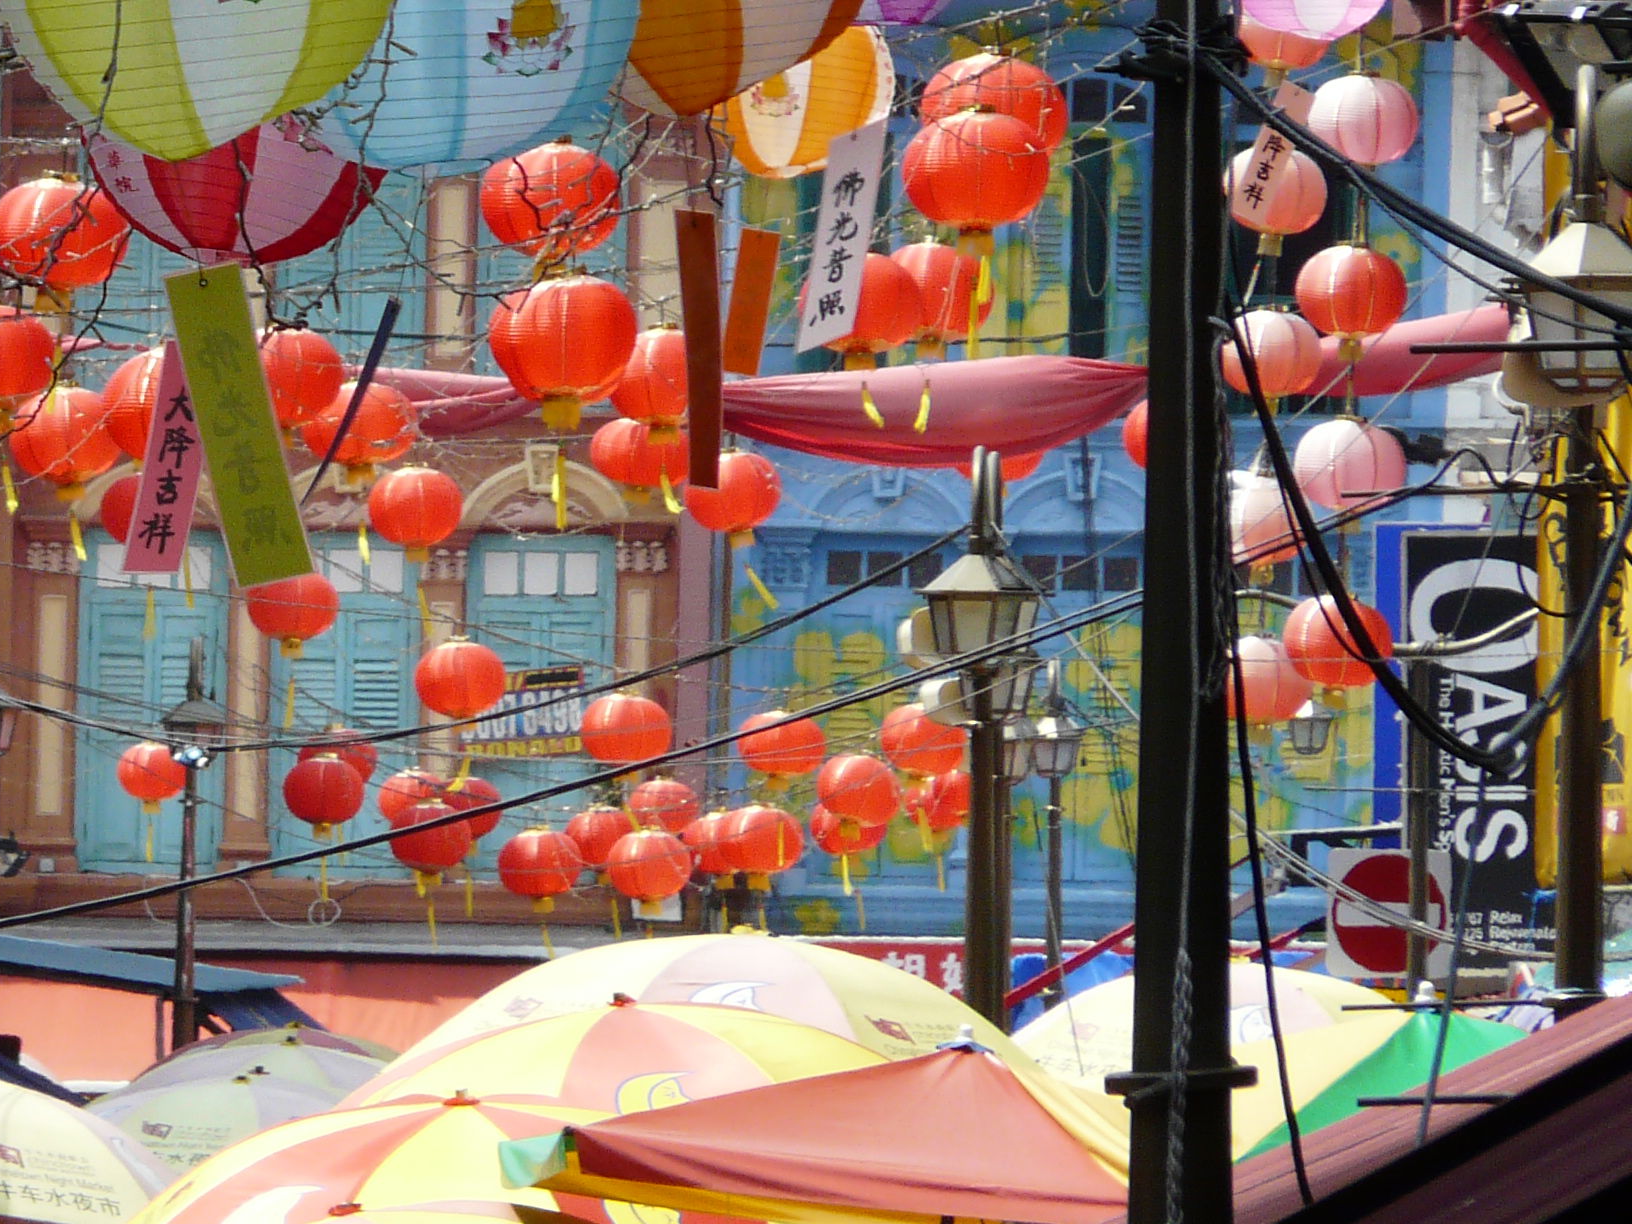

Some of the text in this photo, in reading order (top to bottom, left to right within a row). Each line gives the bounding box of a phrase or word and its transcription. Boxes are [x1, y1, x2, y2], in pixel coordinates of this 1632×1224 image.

[138, 387, 196, 554] 大降吉祥
[1410, 558, 1539, 863] OASIS
